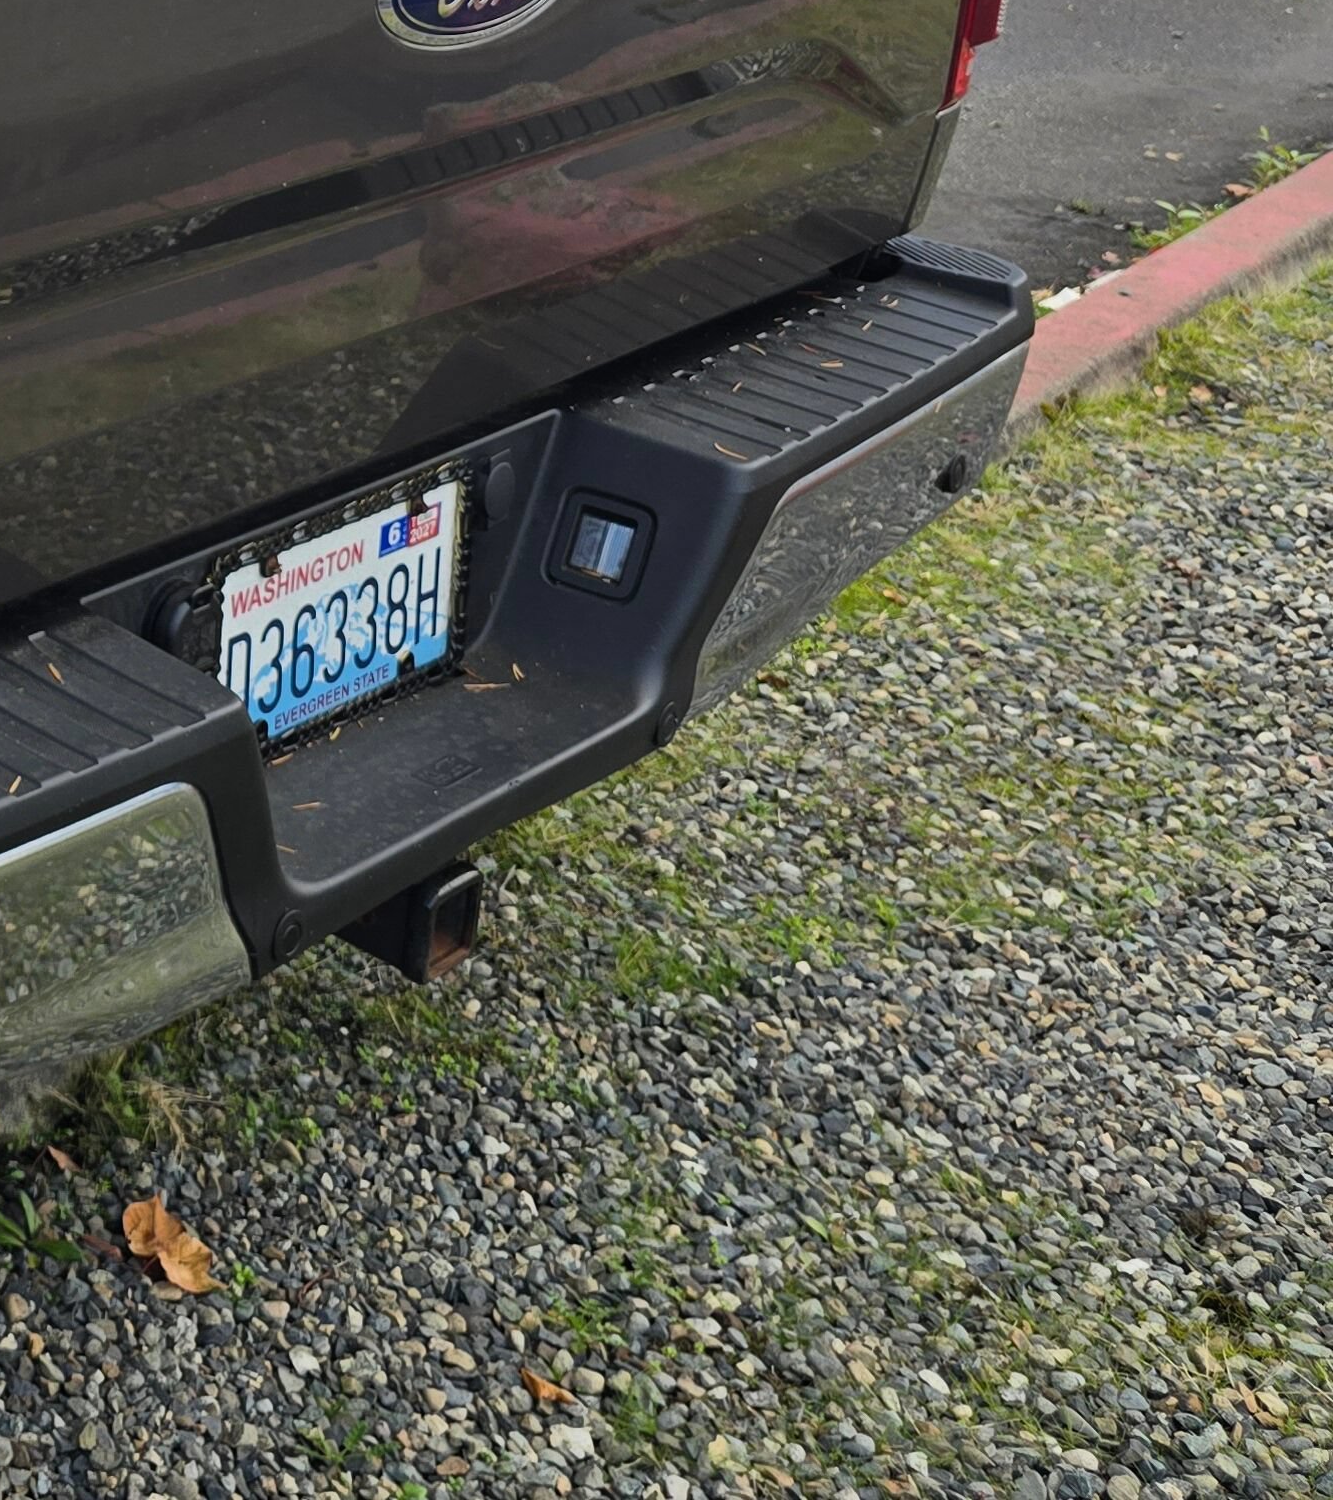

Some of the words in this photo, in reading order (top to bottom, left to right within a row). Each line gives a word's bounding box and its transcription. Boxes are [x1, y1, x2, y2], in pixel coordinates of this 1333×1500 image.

[387, 521, 401, 547] 6
[408, 523, 438, 543] 2027
[230, 540, 364, 618] WASHINGTON
[226, 547, 441, 714] D36338H
[274, 686, 350, 730] EVERGREEN
[353, 663, 390, 693] STATE
